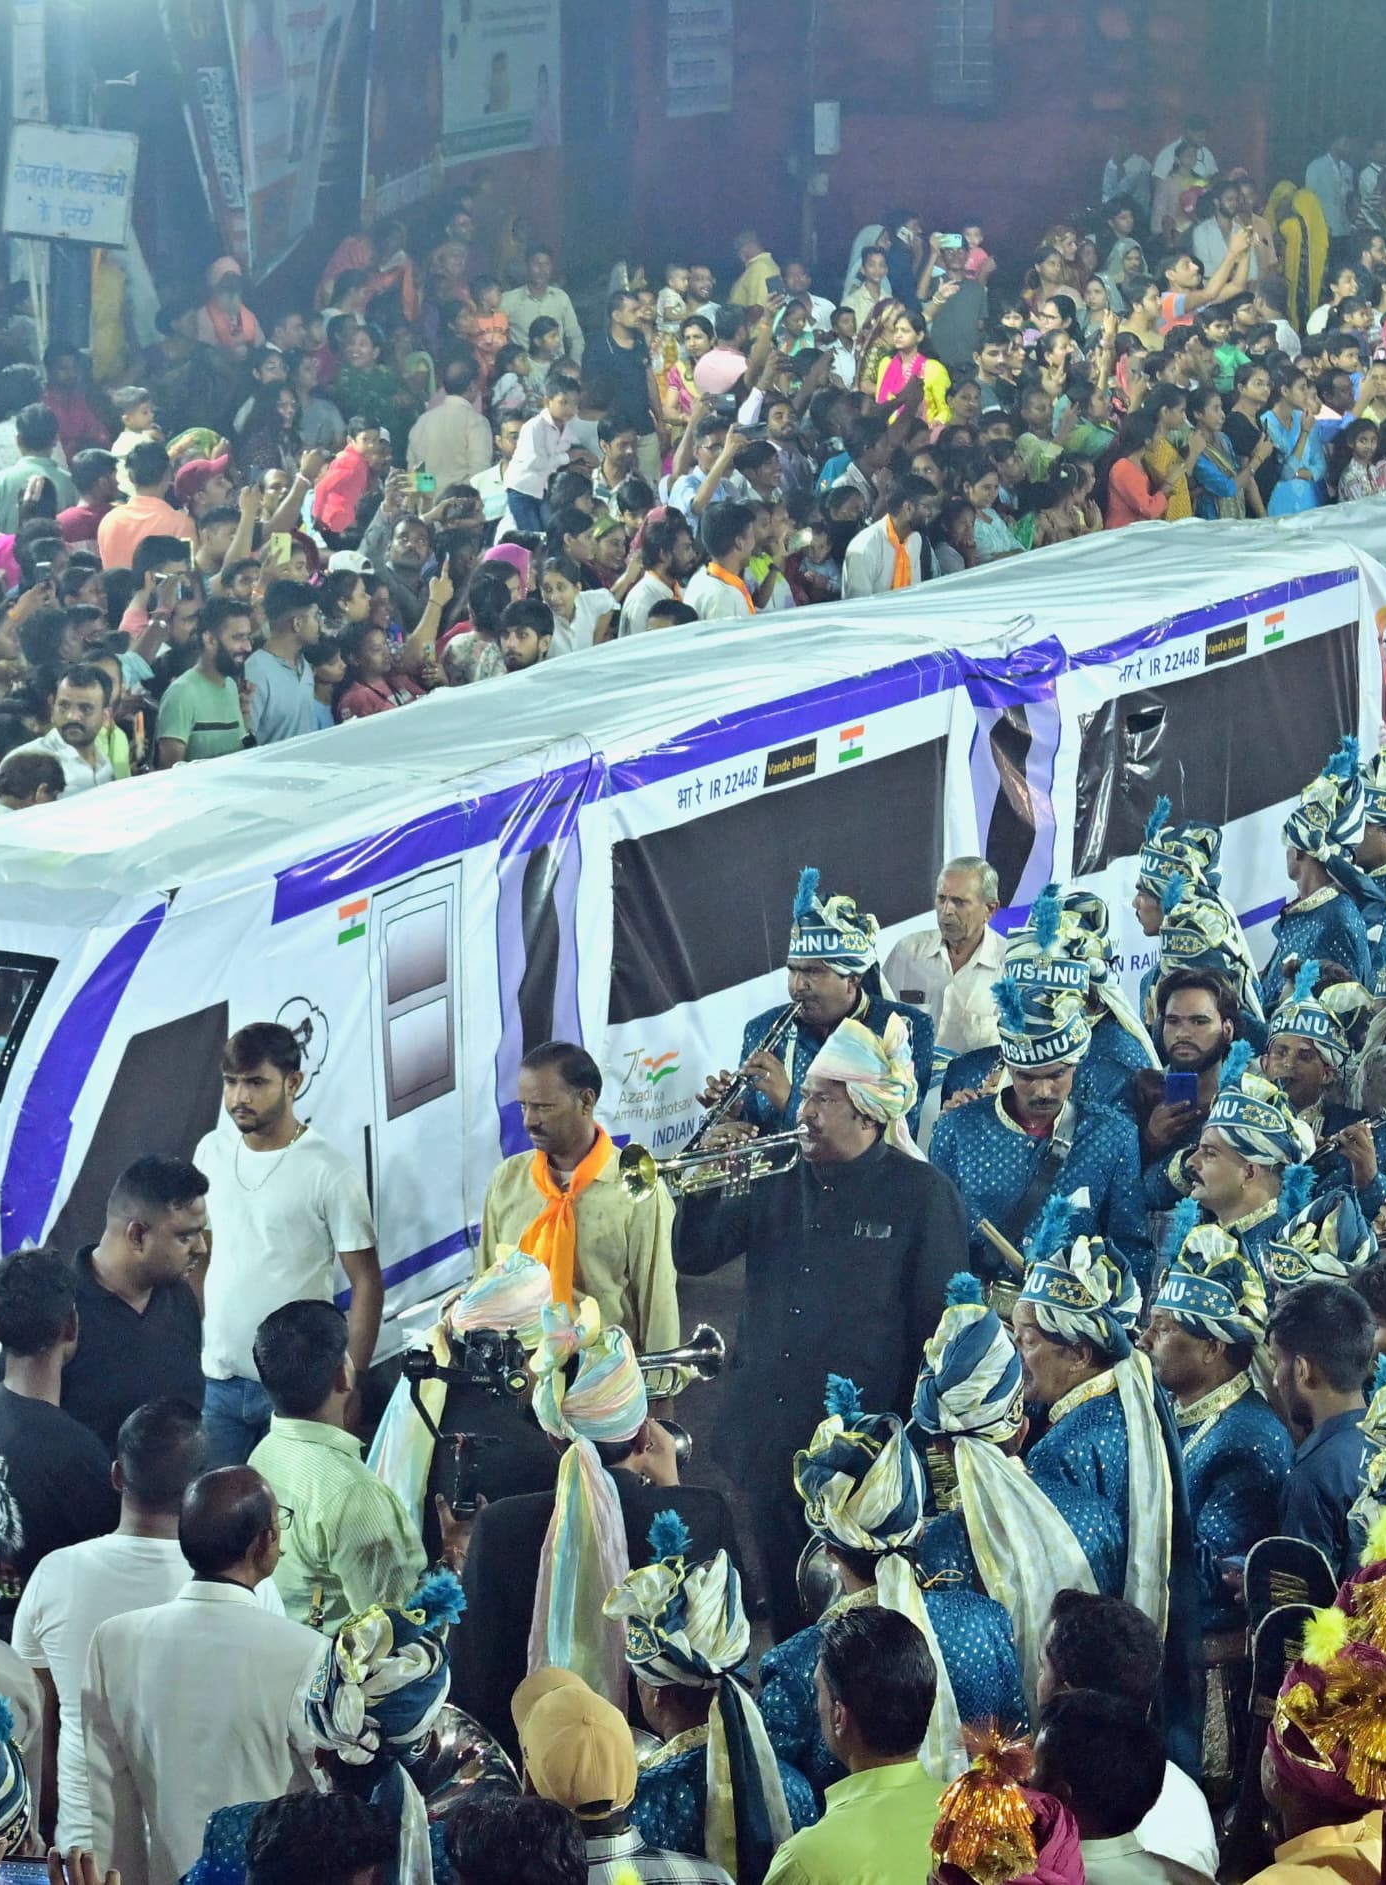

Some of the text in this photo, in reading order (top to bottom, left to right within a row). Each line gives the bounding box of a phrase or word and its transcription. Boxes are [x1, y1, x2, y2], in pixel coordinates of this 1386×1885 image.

[1149, 646, 1200, 677] IR 22448
[767, 751, 816, 776] Vande Bharat
[709, 765, 758, 801] IR 22448
[677, 786, 692, 809] भा
[613, 1107, 643, 1121] Amrit
[644, 1097, 693, 1123] Mahotsav
[618, 1088, 653, 1107] Azadi
[652, 1117, 695, 1149] INDIAN
